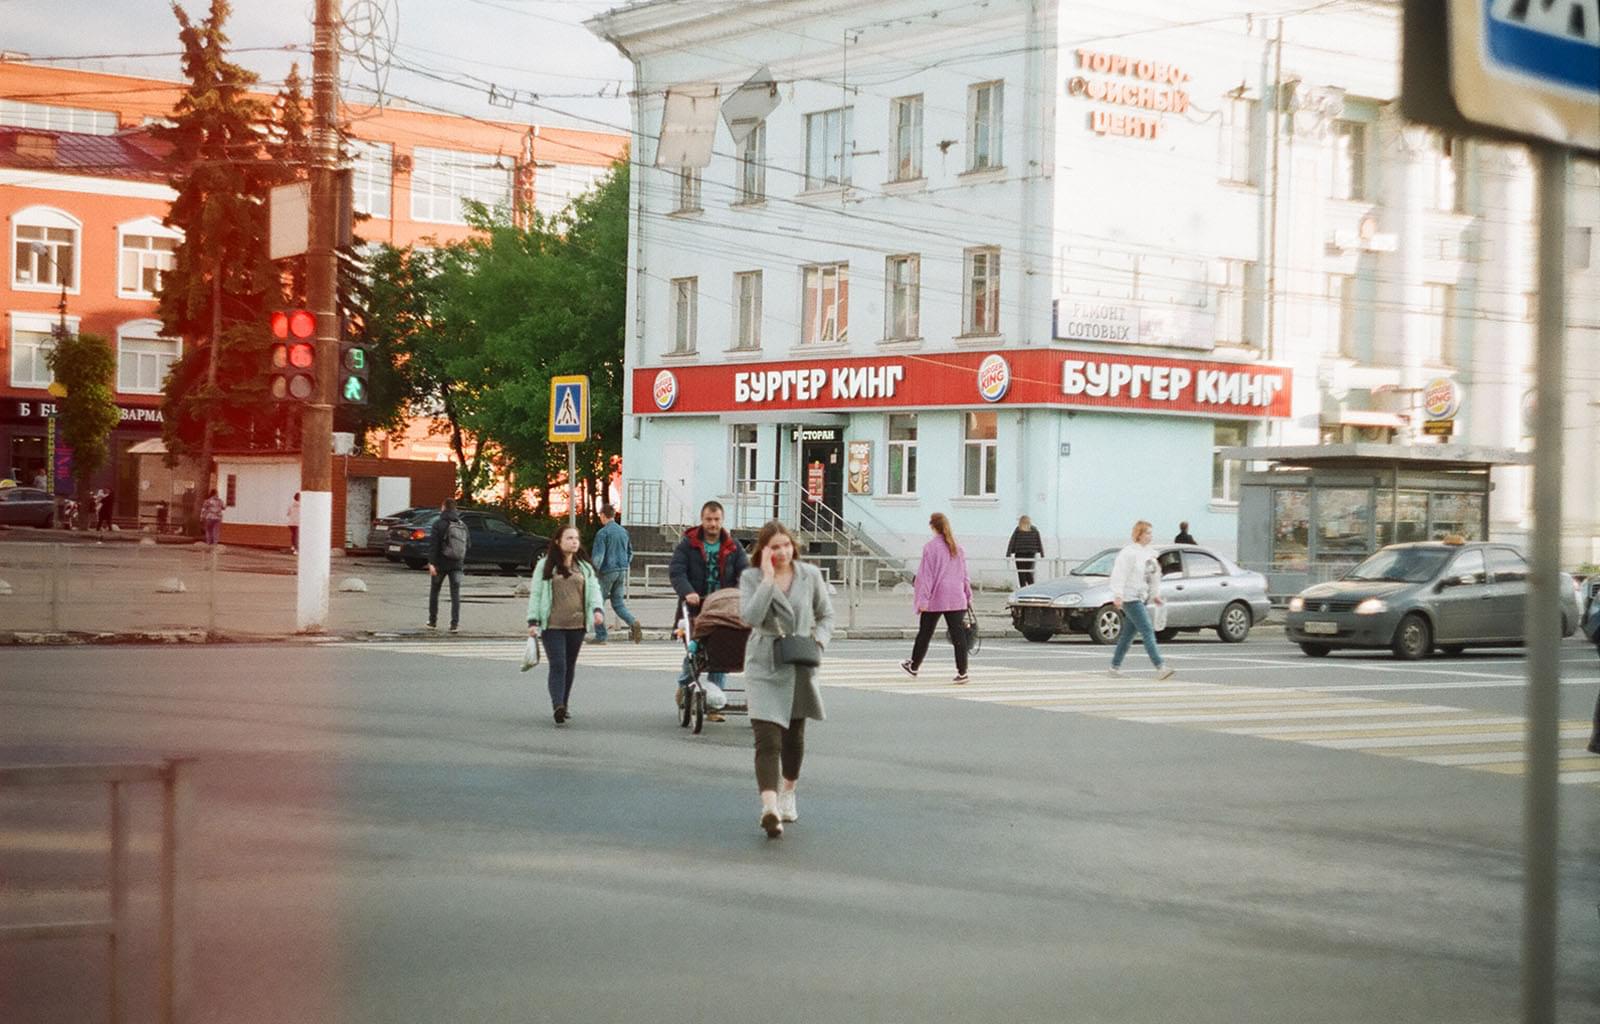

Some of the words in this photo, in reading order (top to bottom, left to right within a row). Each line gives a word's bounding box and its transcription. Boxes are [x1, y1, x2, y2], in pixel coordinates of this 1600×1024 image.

[1067, 321, 1130, 341] СОТОВЫХ
[735, 368, 828, 403] БУРГЕР
[832, 365, 904, 399] КИНГ
[1063, 359, 1192, 401] БУРГЕР
[1196, 369, 1283, 407] КИНГ
[793, 430, 835, 441] РСТОРАН
